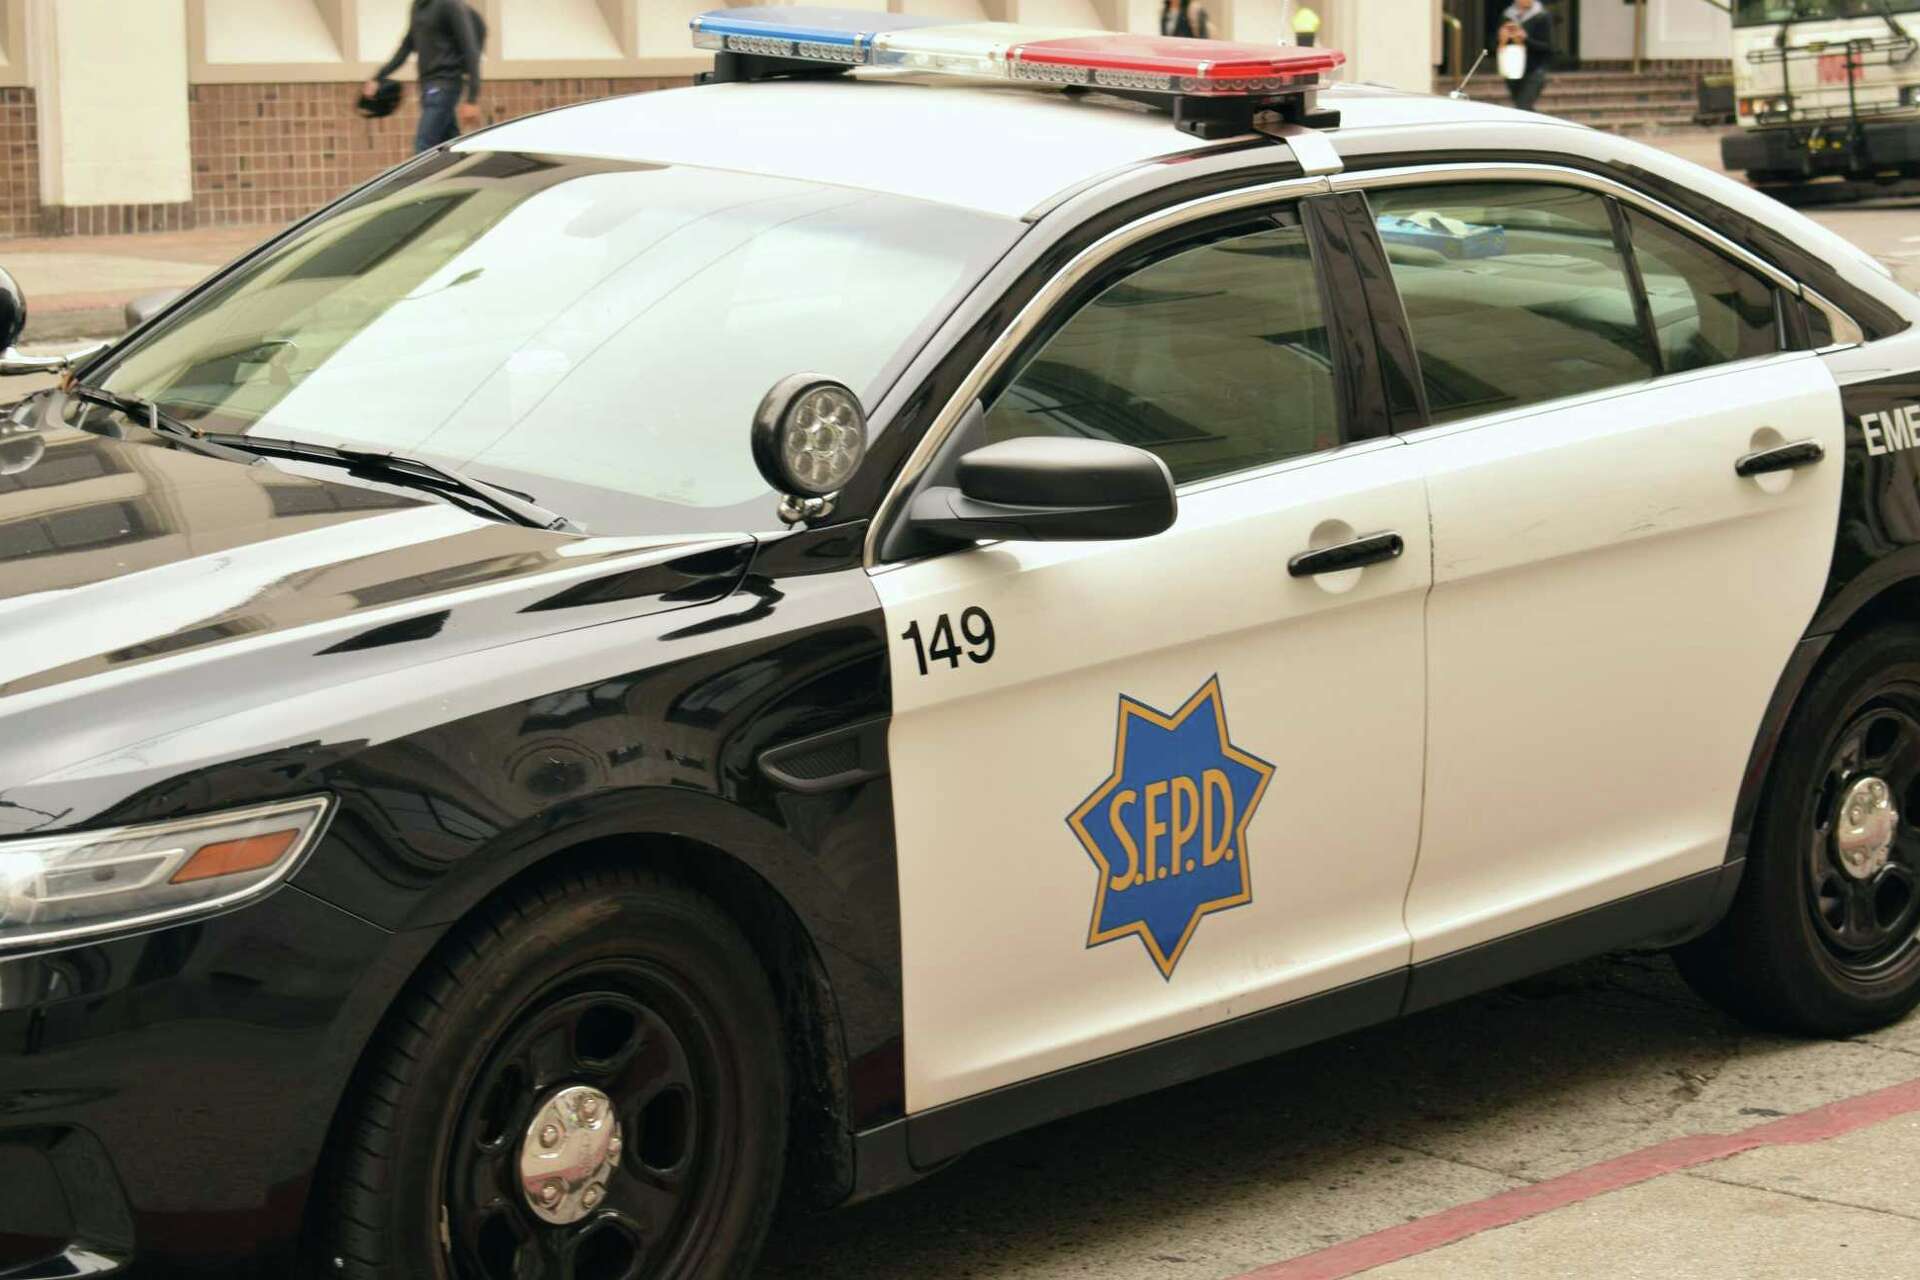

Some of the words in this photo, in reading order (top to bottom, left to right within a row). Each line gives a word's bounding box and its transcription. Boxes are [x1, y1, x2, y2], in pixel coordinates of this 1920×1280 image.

[1860, 404, 1920, 456] EME
[901, 606, 996, 675] 149
[1109, 768, 1235, 892] S.F.P.D.
